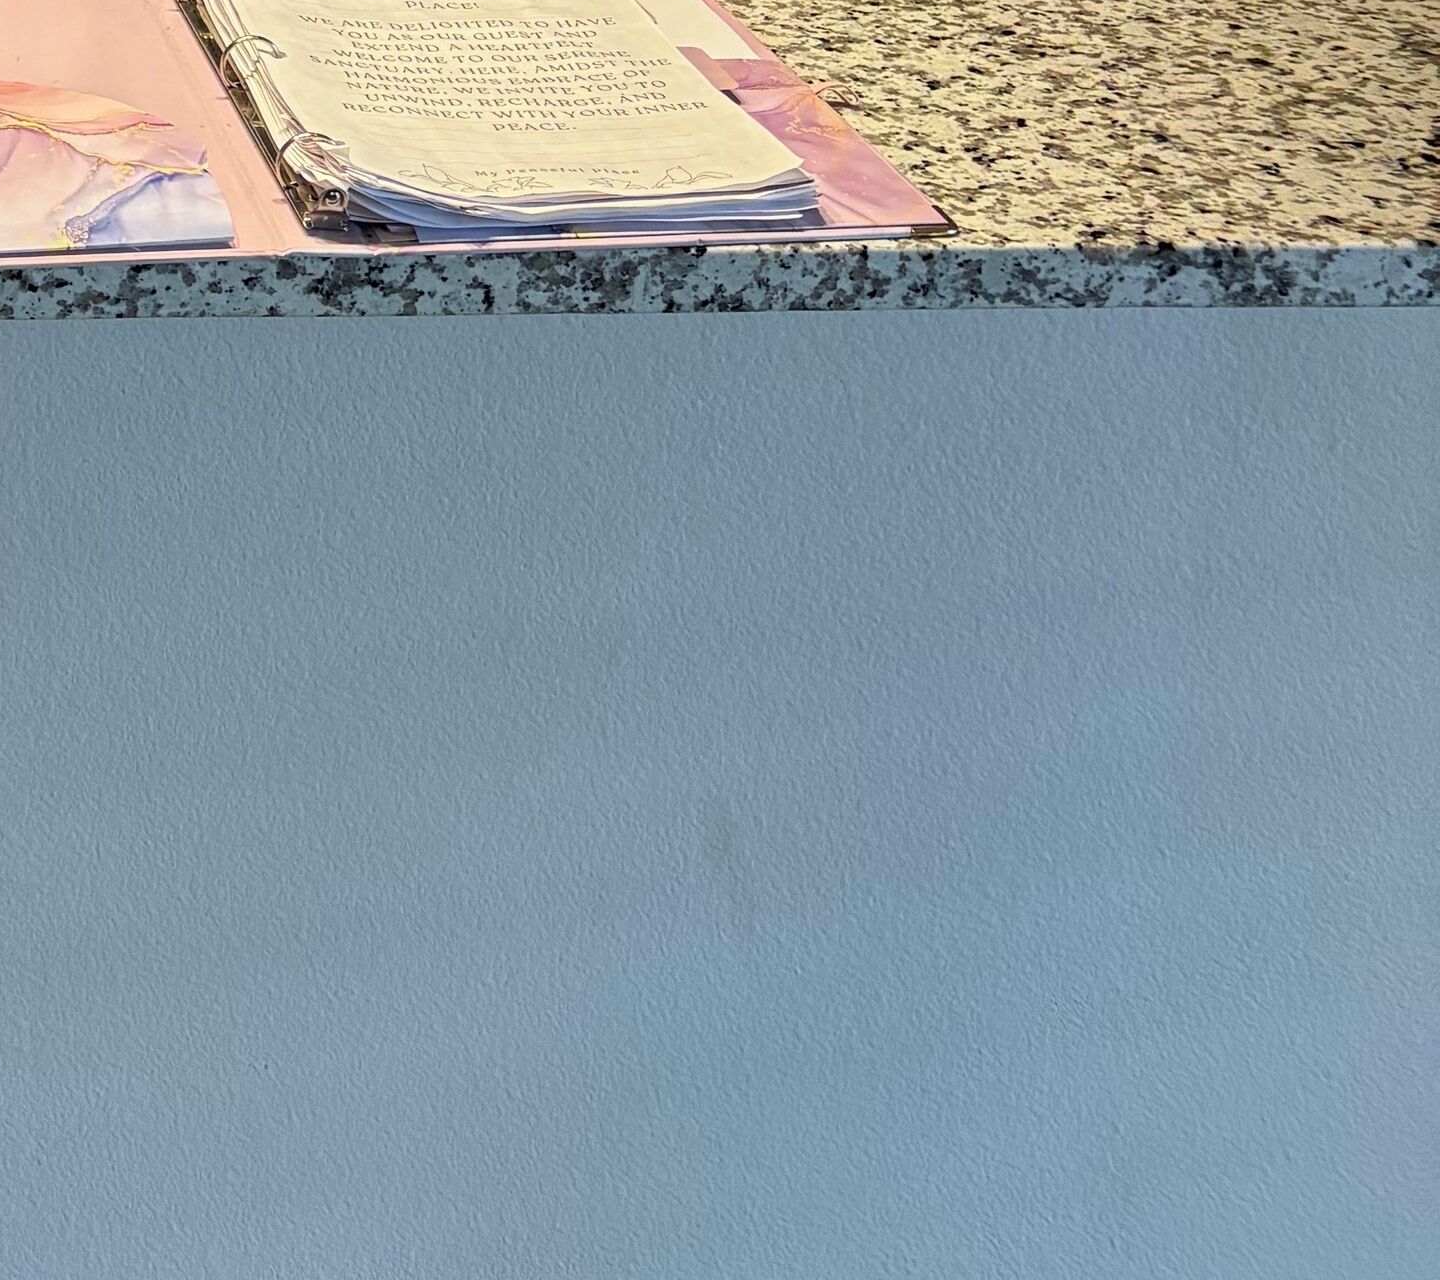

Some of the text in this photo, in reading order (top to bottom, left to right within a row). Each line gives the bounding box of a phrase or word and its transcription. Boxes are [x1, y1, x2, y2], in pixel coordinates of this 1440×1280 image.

[404, 0, 480, 10] PLACE!
[298, 14, 616, 31] WE ARE DELIGHTED TO HAVE
[332, 28, 378, 40] YOU
[472, 31, 544, 40] GUEST
[553, 30, 597, 38] AND
[352, 41, 440, 52] EXTEND
[469, 40, 594, 52] HEARTFELT
[332, 49, 448, 64] WELCOME
[491, 54, 538, 62] OUR
[544, 50, 631, 62] SERENE
[460, 66, 528, 75] HERE,
[534, 60, 618, 73] AMIDST
[624, 58, 672, 66] THE
[343, 70, 651, 85] HARMONIOUS EMBRACE OF
[346, 81, 447, 94] NATURE,
[496, 86, 575, 94] INVITE
[579, 82, 629, 92] YOU
[634, 80, 666, 88] TO
[364, 92, 666, 107] UNWIND, RECHARGE, AND
[342, 100, 709, 120] RECONNECT WITH YOUR INNER
[492, 122, 576, 132] PEACE.
